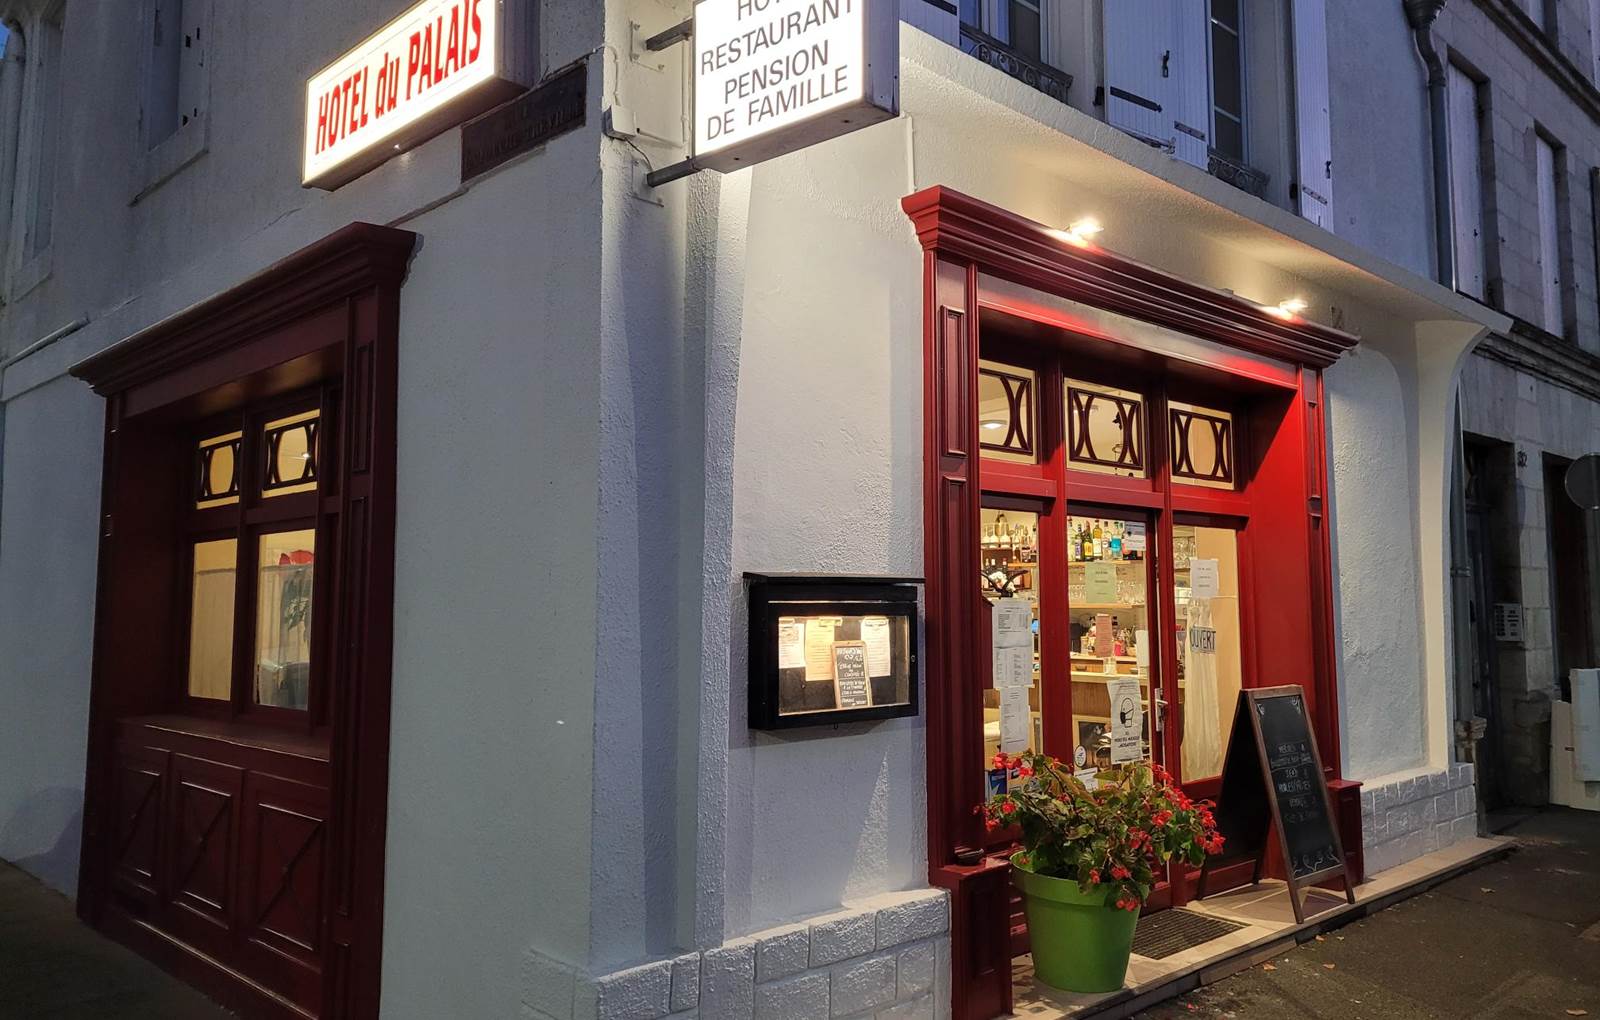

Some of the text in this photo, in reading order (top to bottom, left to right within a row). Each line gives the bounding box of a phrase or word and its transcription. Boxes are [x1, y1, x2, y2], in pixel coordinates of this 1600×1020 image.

[315, 65, 369, 155] HOTEL
[375, 52, 400, 119] du
[405, 0, 482, 101] PALAIS
[707, 65, 848, 141] DE FAMILLE
[725, 40, 829, 104] PENSION
[1189, 628, 1217, 651] OUVERT
